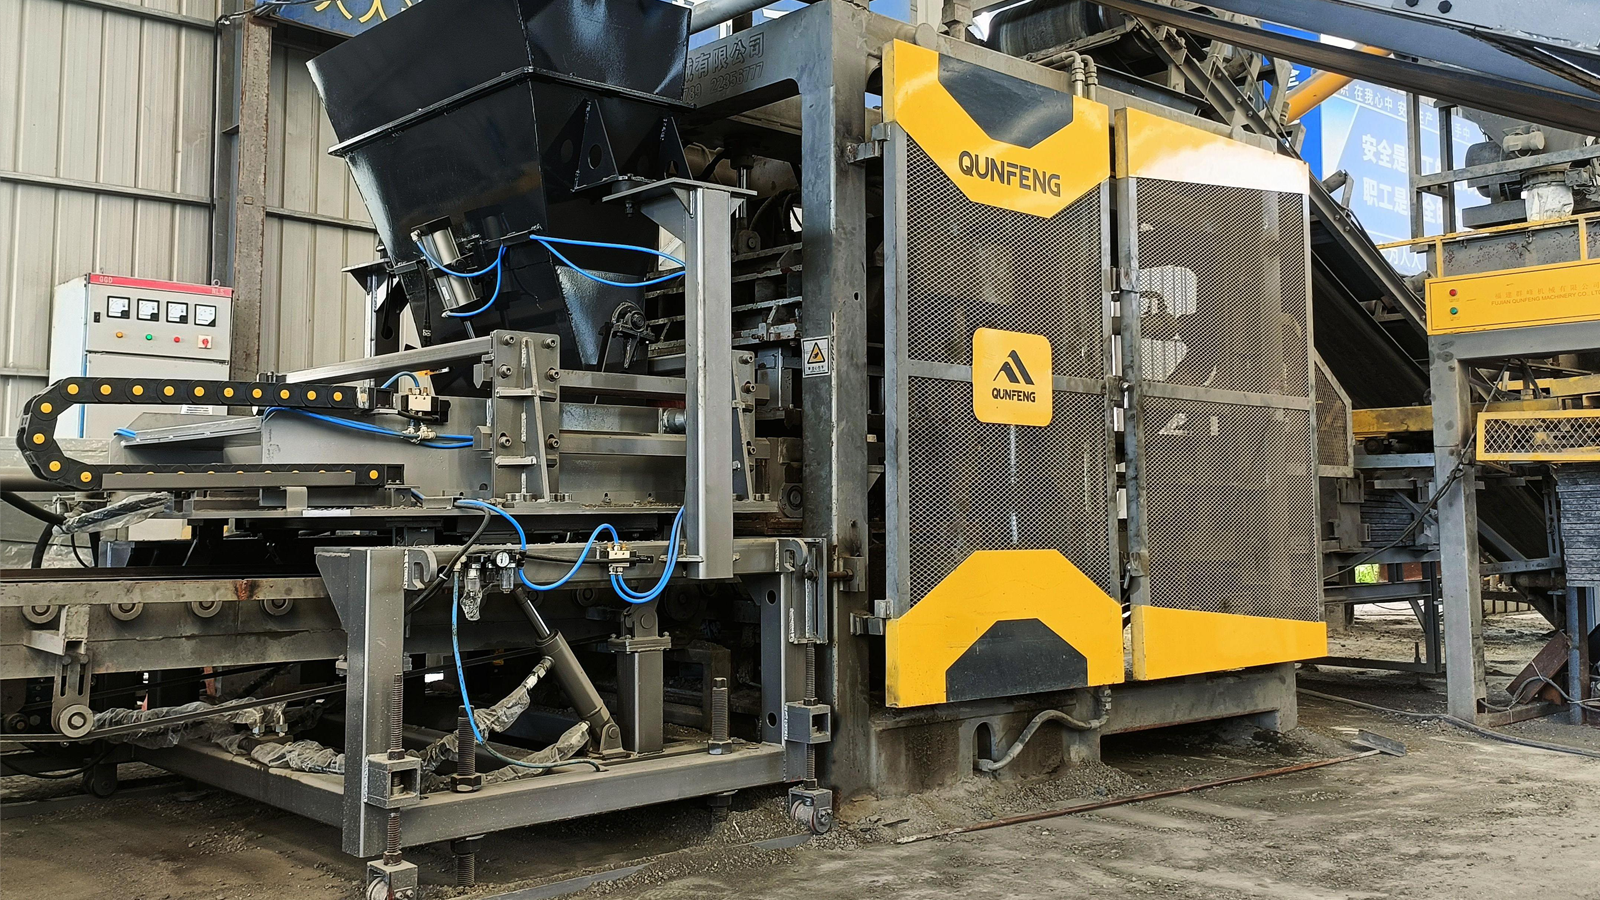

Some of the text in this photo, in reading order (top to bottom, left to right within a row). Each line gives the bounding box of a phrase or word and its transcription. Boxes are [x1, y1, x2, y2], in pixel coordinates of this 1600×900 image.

[710, 61, 764, 94] 22356777
[1354, 85, 1393, 112] 在我心中
[959, 150, 1061, 197] QUNFENG
[1512, 296, 1540, 304] QUNFENG
[1541, 292, 1577, 301] MACHINERY
[991, 387, 1036, 403] QUNFENG
